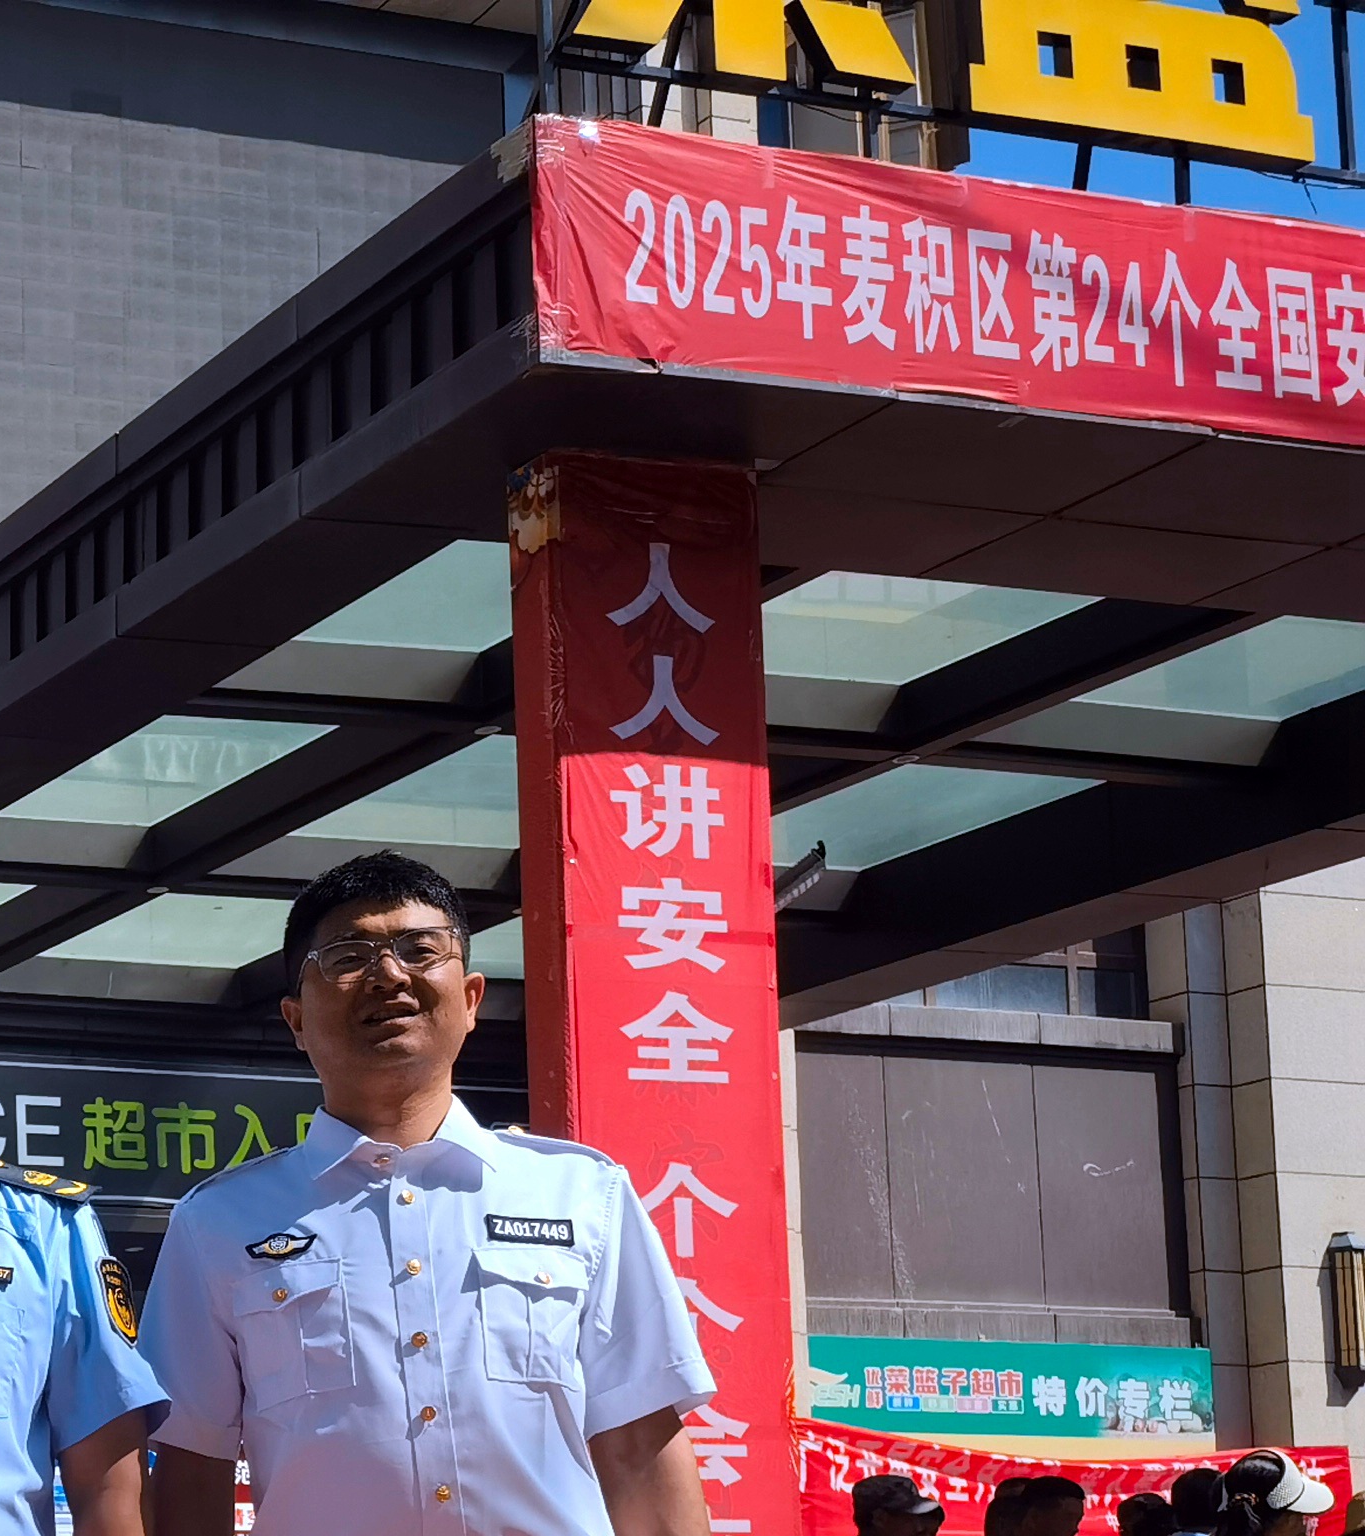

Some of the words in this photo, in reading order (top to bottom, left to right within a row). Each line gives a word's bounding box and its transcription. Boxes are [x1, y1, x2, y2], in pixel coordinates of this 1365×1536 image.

[82, 1096, 315, 1174] 超市入
[493, 1218, 569, 1241] ZA017449
[1032, 1375, 1194, 1421] 特价专栏
